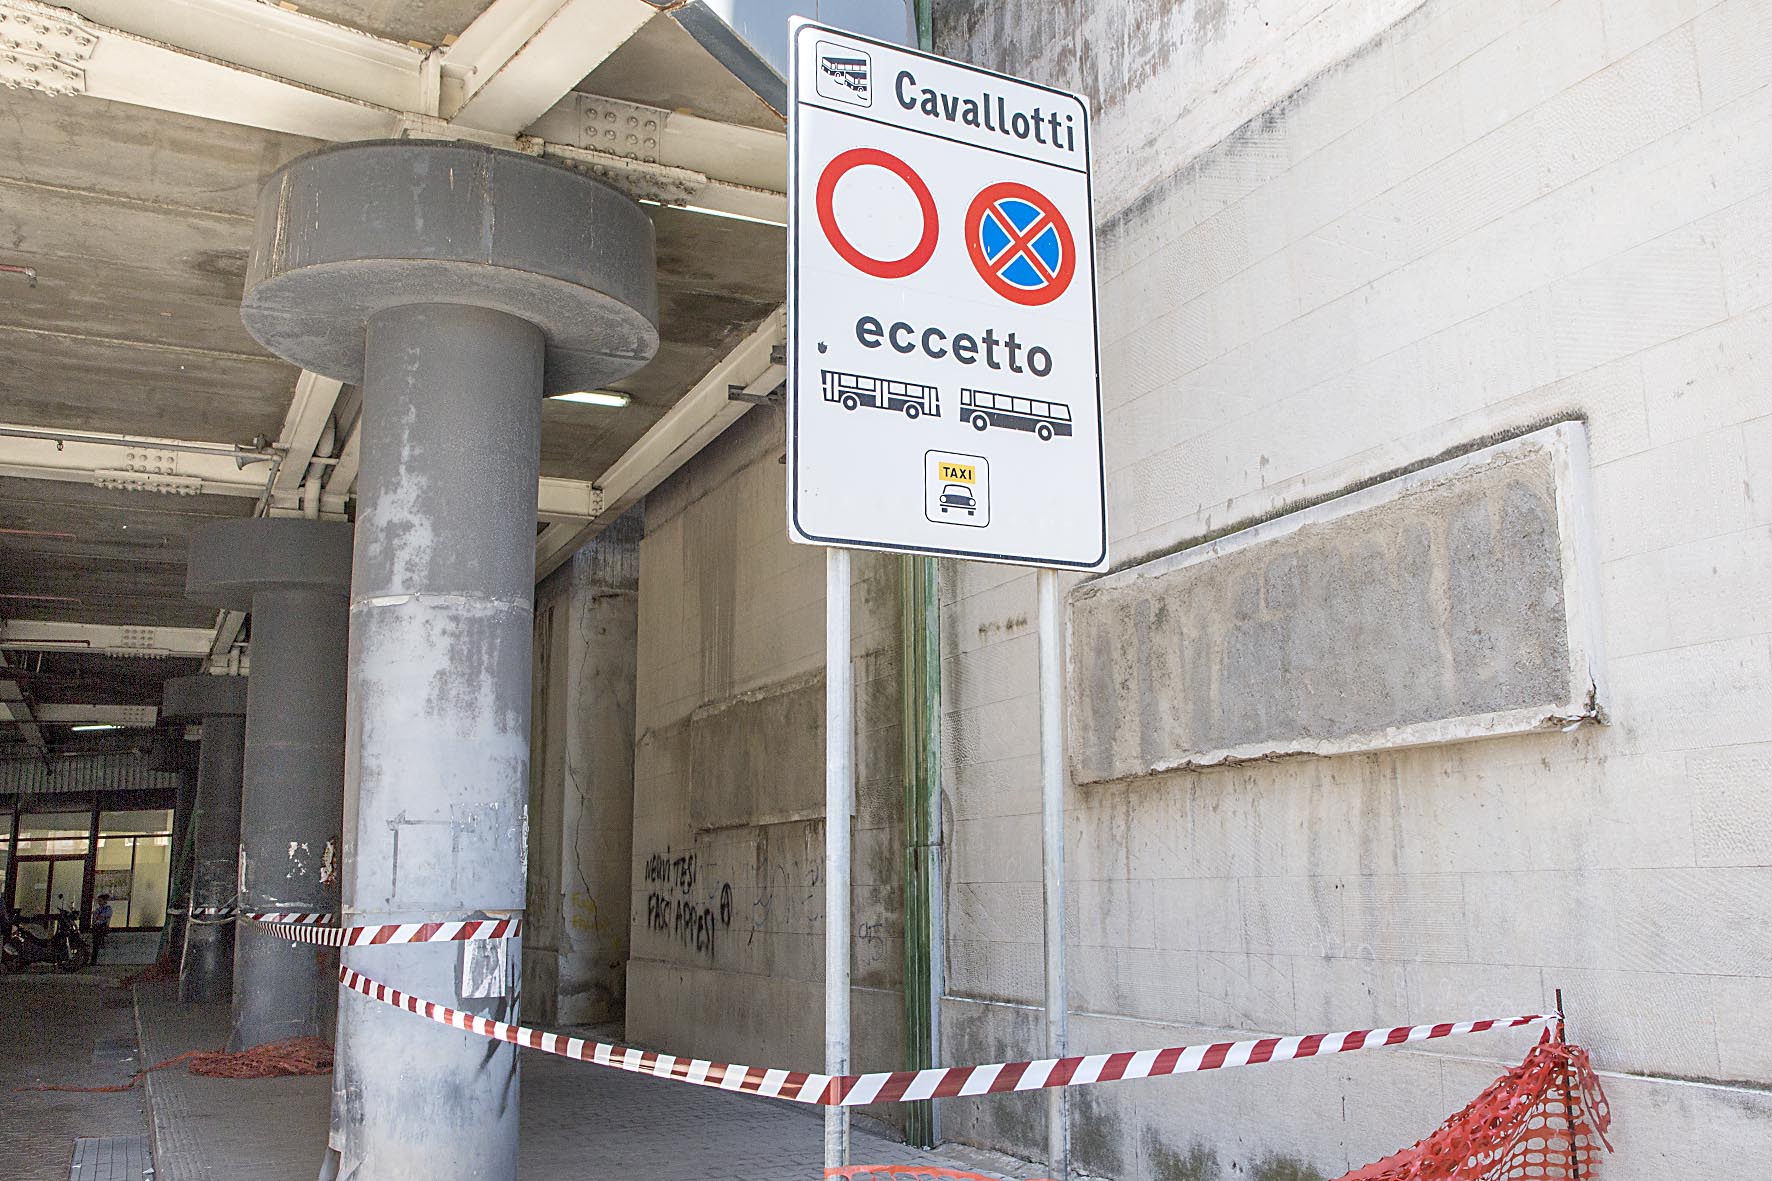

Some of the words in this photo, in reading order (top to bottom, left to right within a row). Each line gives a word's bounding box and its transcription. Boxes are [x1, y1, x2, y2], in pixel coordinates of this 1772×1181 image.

[894, 70, 1075, 152] Cavallotti
[855, 315, 1053, 377] eccetto
[943, 466, 972, 480] TAXI
